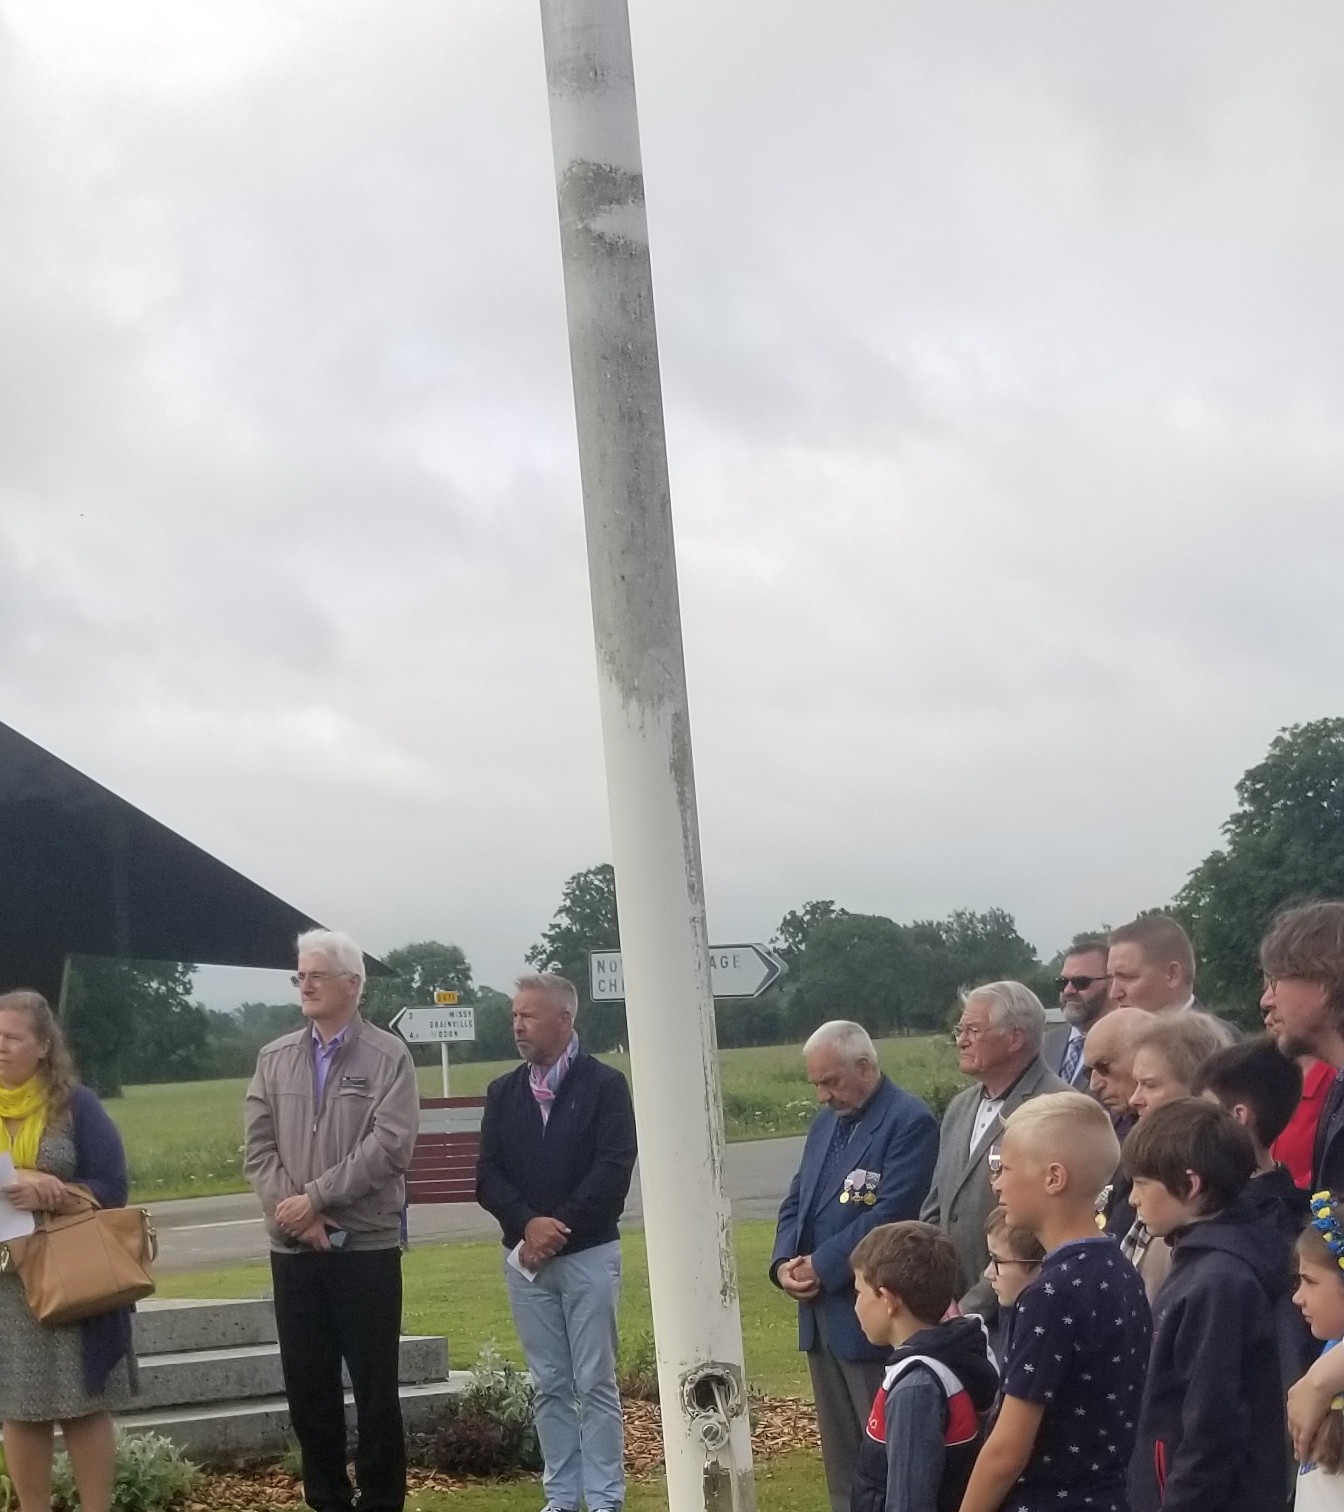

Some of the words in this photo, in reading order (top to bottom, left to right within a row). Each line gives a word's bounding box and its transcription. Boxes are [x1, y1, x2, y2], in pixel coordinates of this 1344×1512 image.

[597, 959, 623, 973] NO
[709, 955, 741, 969] AGE
[598, 980, 625, 993] CH
